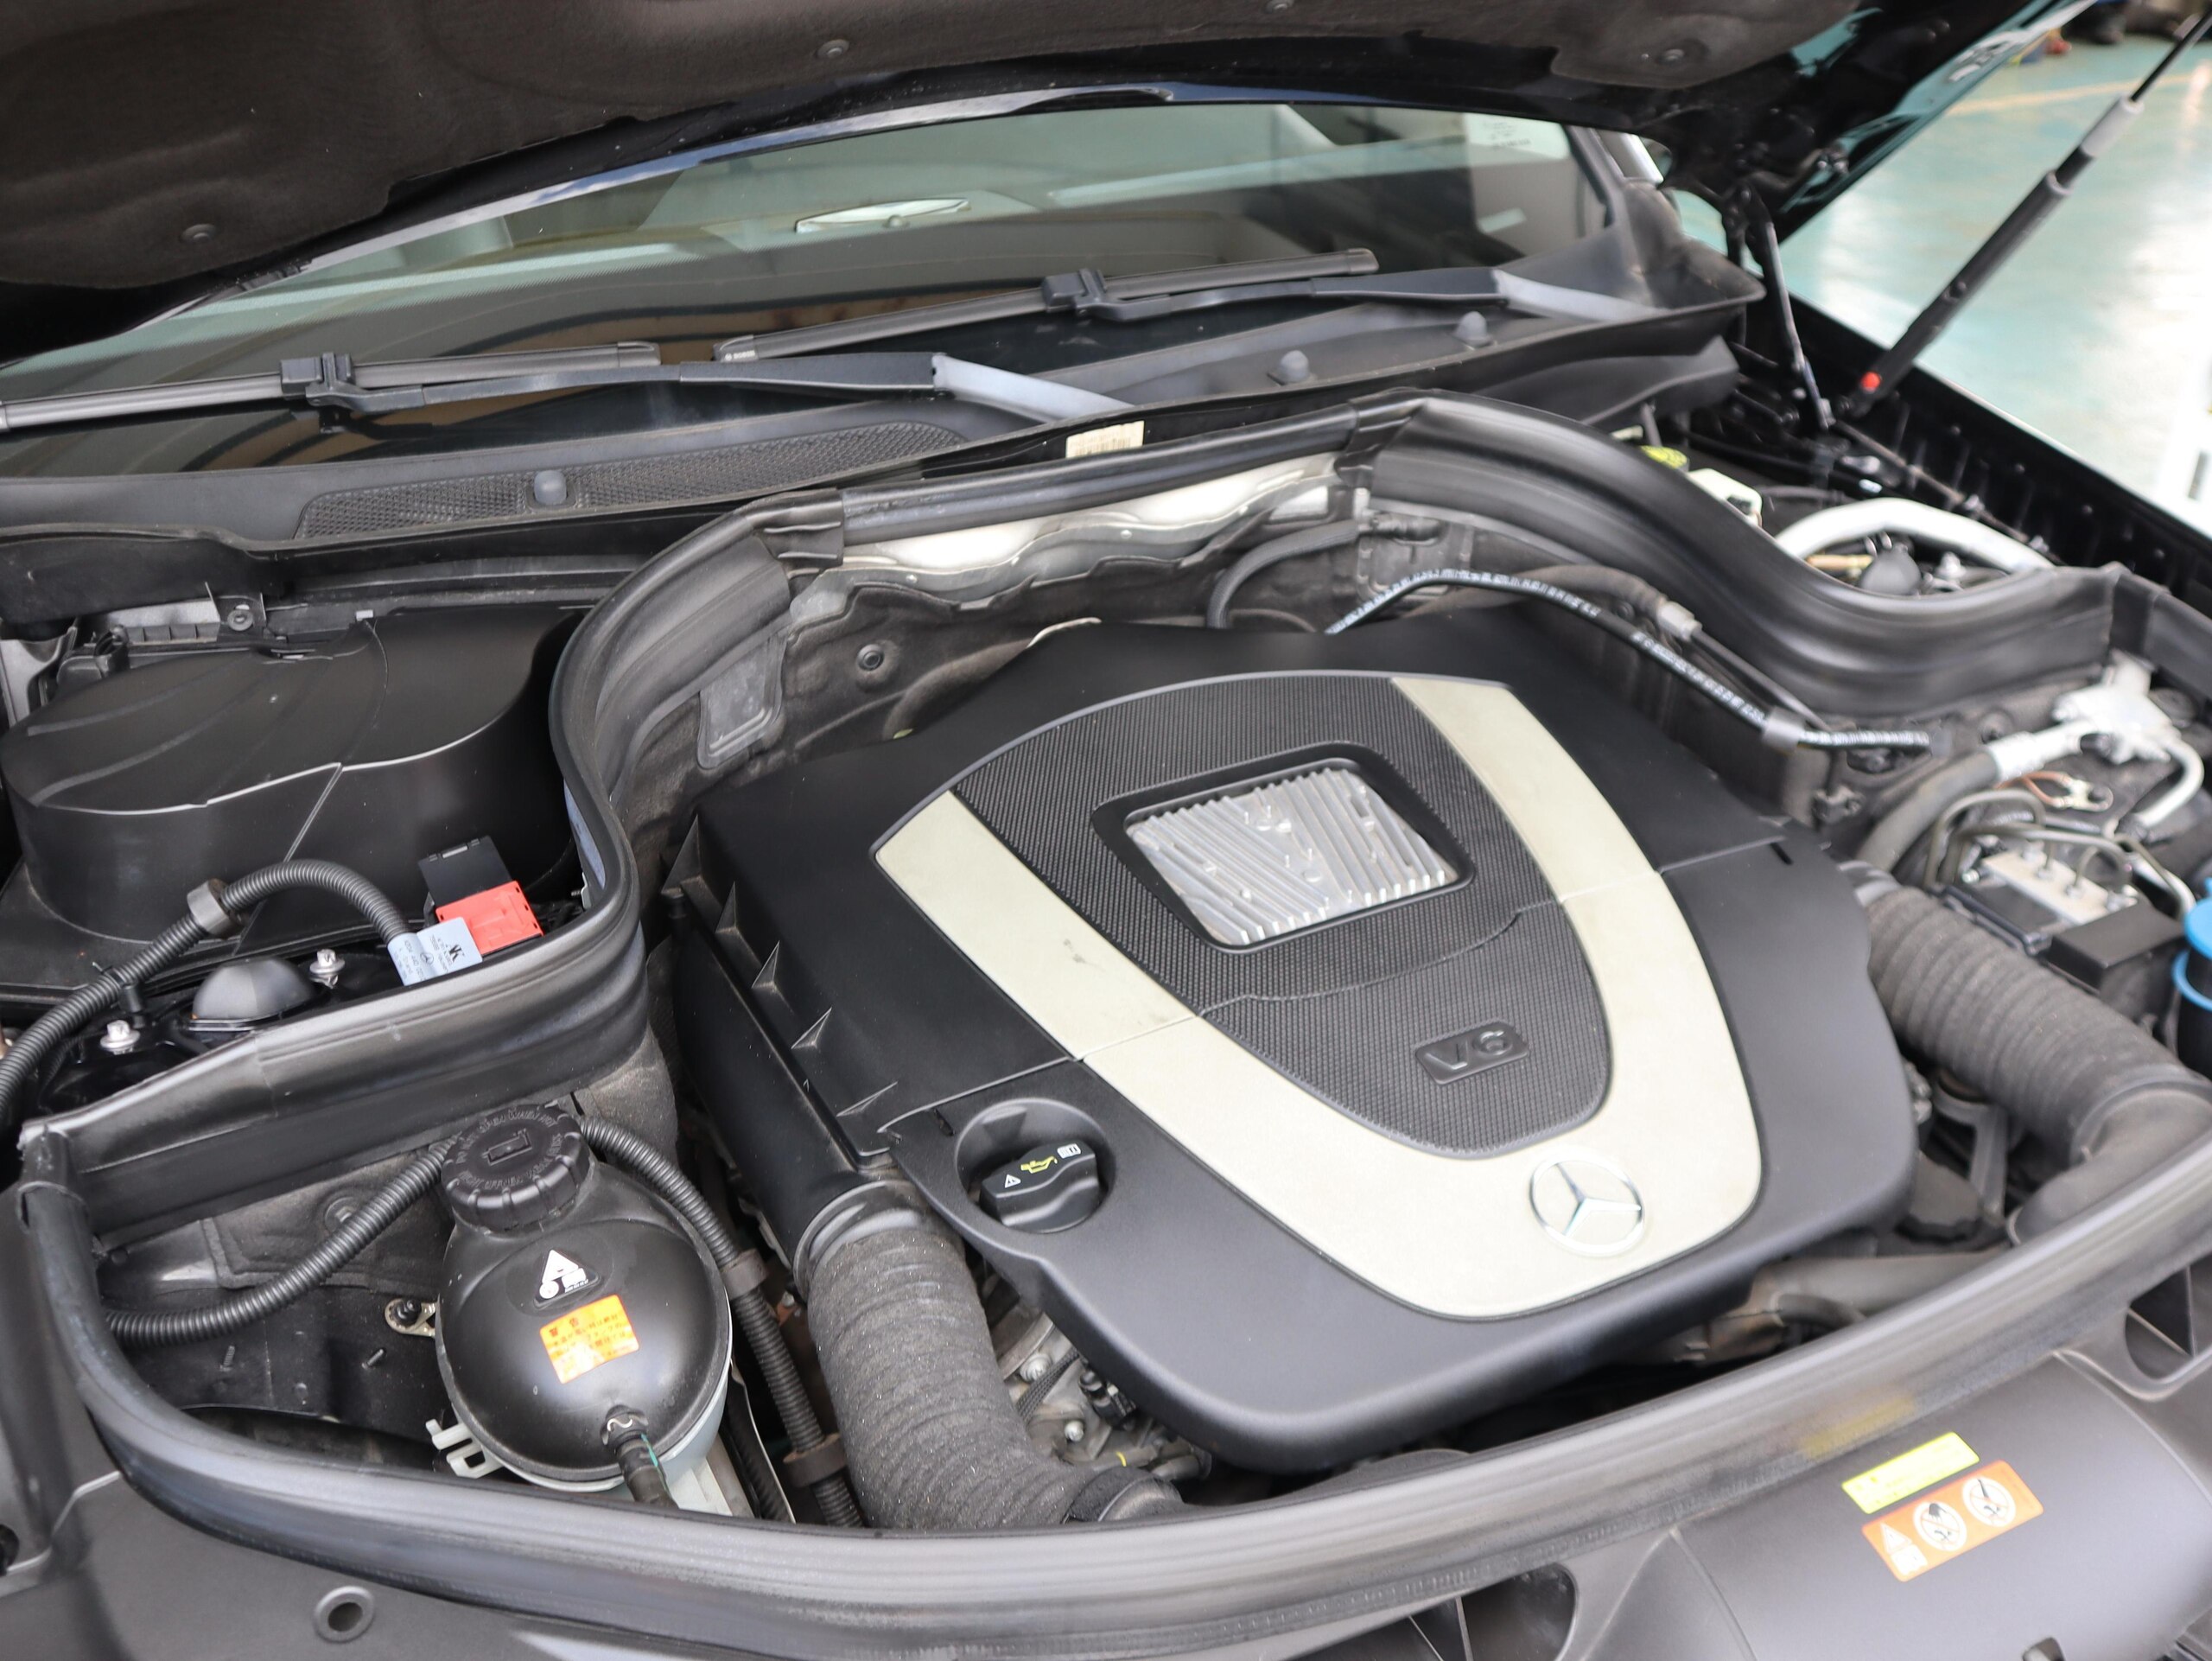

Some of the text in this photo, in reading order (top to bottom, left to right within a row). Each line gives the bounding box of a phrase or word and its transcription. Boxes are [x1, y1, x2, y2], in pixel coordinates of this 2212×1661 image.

[1424, 1029, 1513, 1071] V6
[479, 1115, 505, 1134] OPEN
[508, 1107, 540, 1122] WHEN
[538, 1115, 558, 1128] HOT
